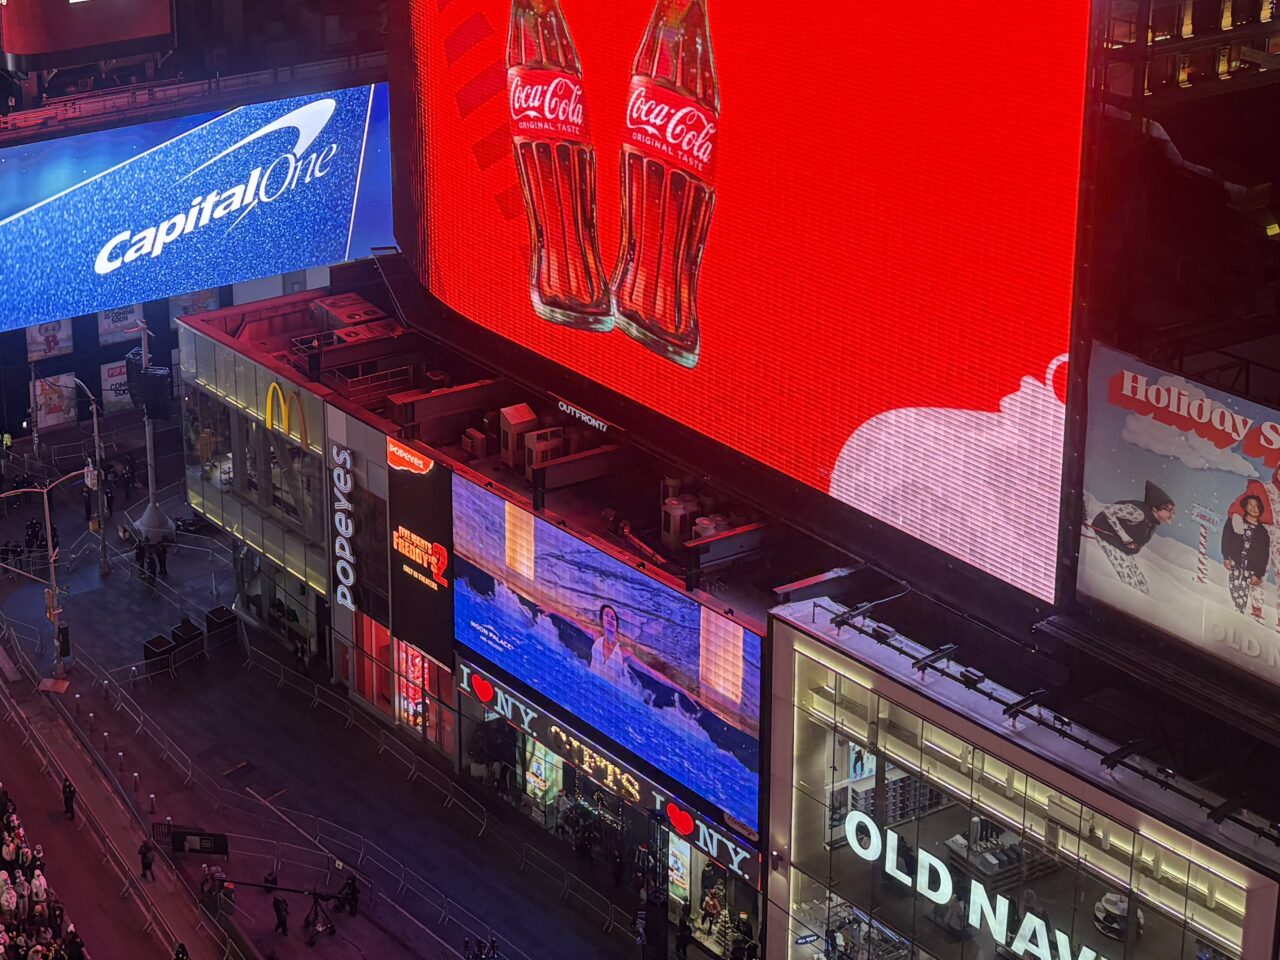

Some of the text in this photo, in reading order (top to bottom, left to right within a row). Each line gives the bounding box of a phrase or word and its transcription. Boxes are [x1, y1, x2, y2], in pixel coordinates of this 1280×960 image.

[509, 77, 584, 126] Coca-Cola
[518, 121, 580, 135] ORIGINAL TASTE
[626, 87, 716, 163] Coca-Cola
[632, 132, 703, 171] ORIGINAL TASTE
[111, 315, 128, 325] SOON
[110, 381, 128, 392] COM
[1121, 370, 1255, 442] Holiday
[392, 530, 449, 588] FREDDY'S 2
[471, 620, 488, 635] MOON
[489, 632, 514, 650] PALACE
[1211, 623, 1261, 657] OLD
[459, 664, 471, 691] I
[844, 810, 953, 905] OLD
